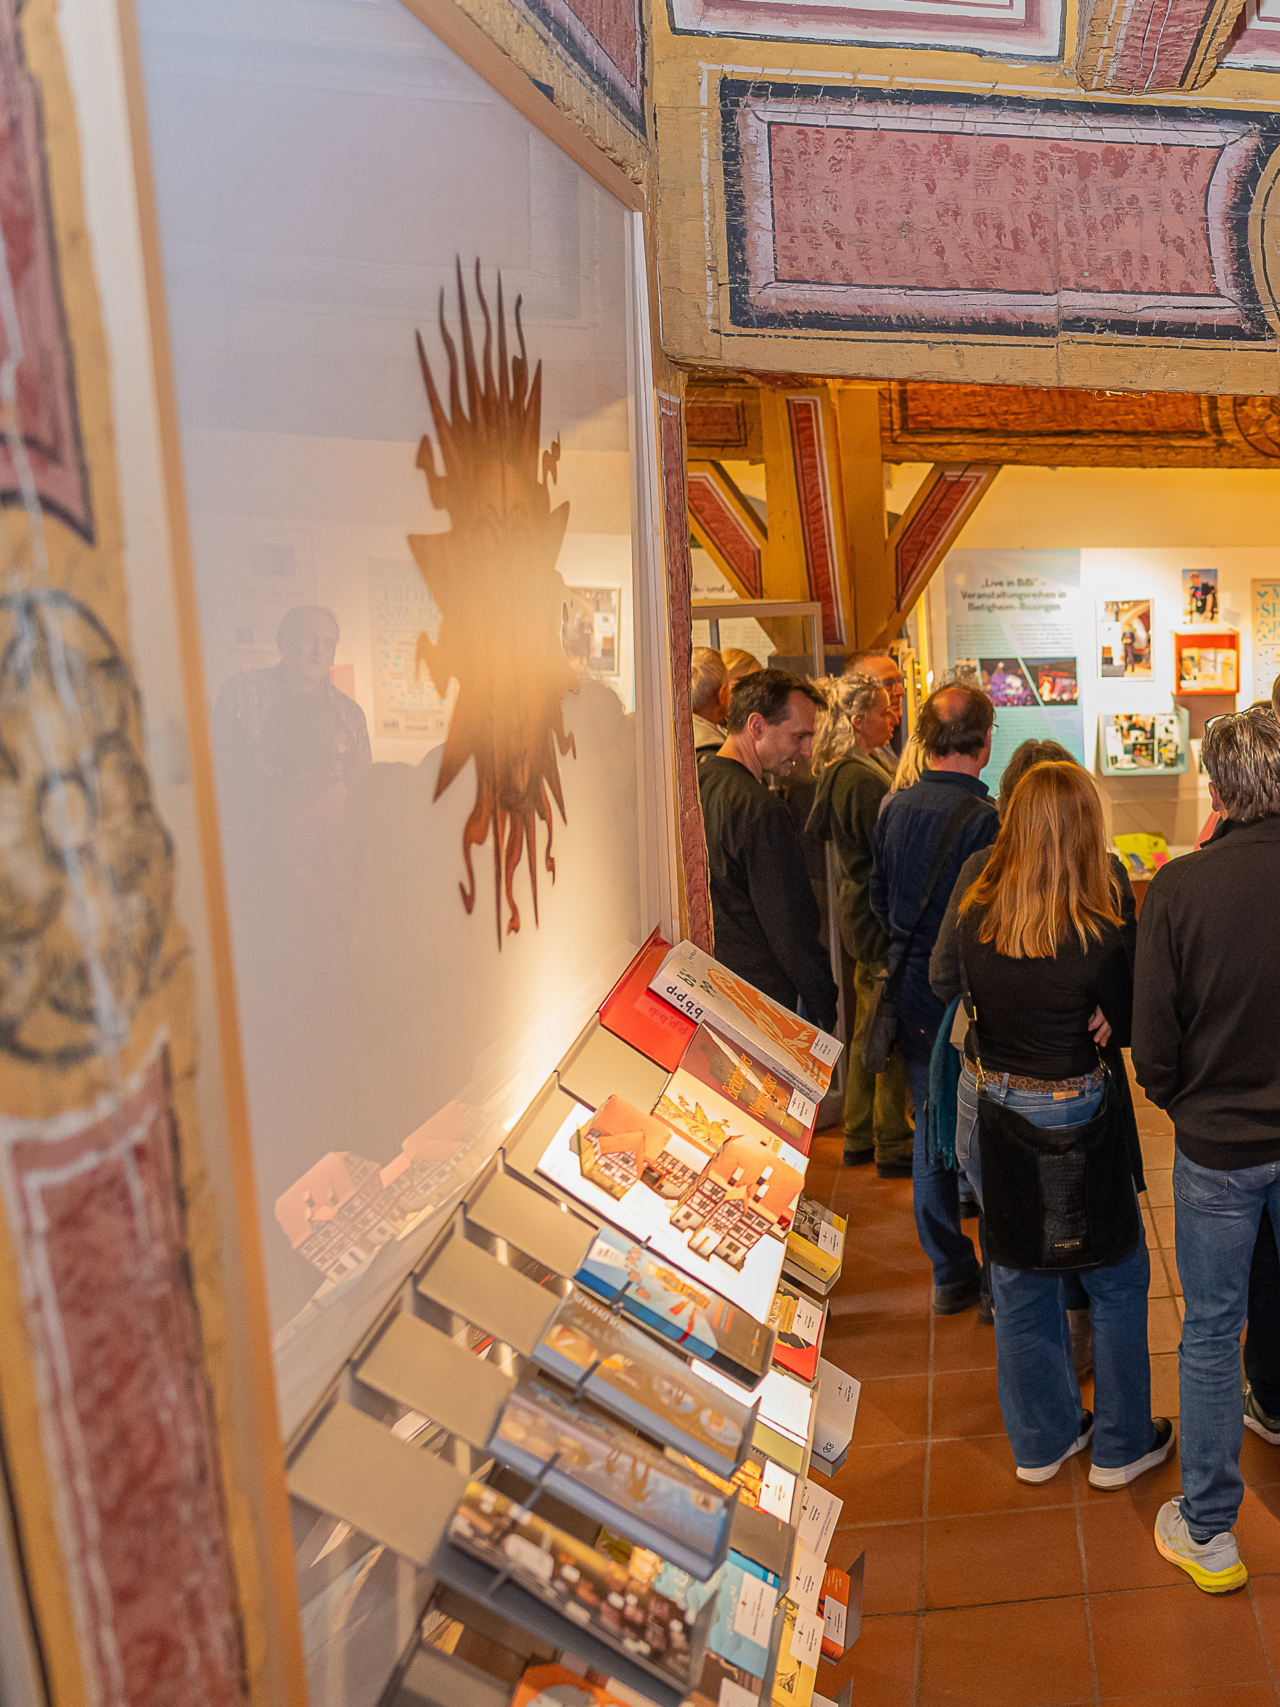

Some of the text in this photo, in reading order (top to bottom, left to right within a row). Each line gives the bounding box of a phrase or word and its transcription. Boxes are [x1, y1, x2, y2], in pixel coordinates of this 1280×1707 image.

[961, 590, 1067, 602] Veranstaltungsreihen in
[967, 602, 1061, 614] Bietigheim-Bissingen
